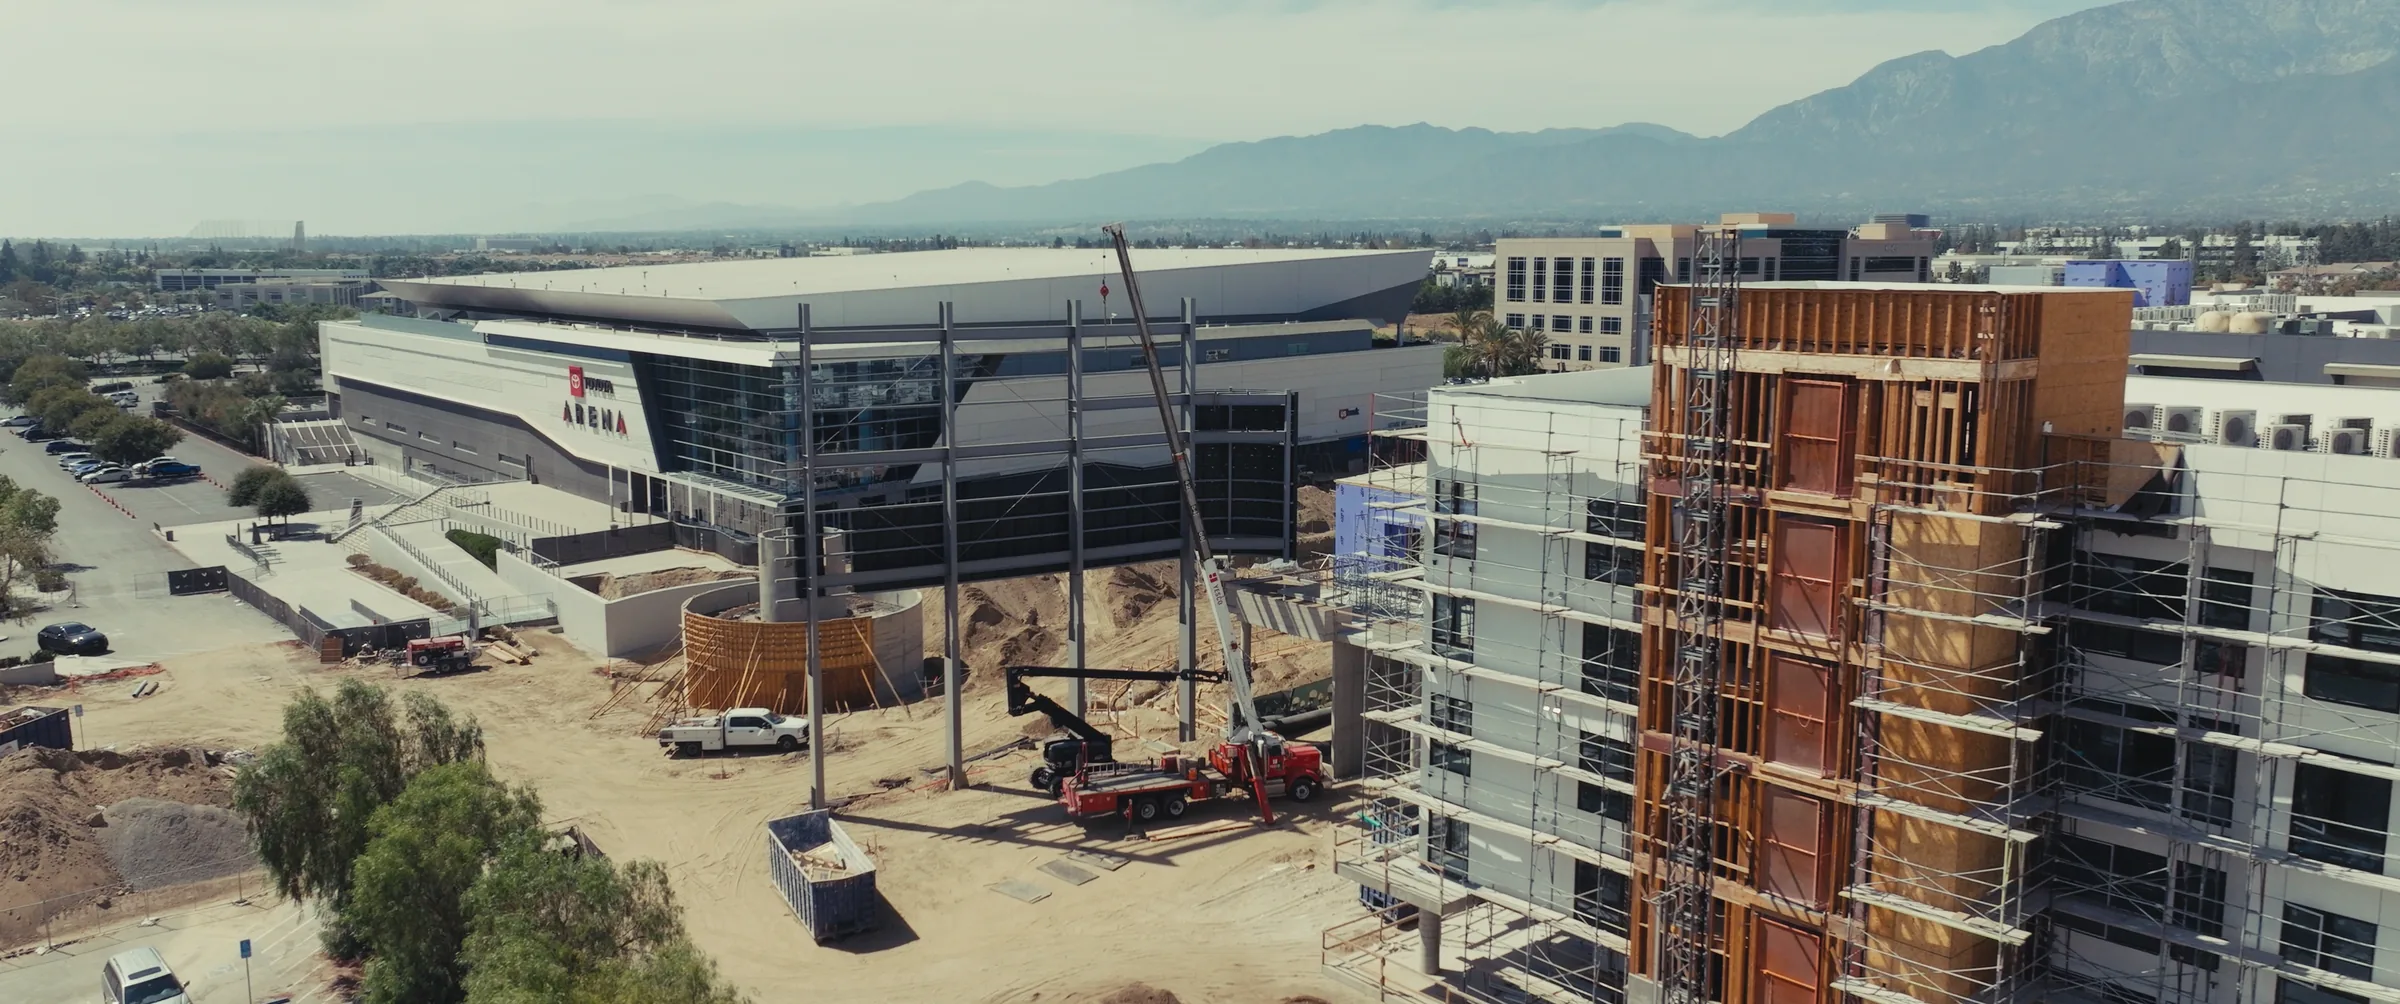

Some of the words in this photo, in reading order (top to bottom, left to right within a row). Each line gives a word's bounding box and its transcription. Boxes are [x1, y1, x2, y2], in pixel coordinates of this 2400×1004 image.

[584, 376, 614, 394] TOYOTA
[563, 400, 627, 434] ARENA
[1213, 583, 1223, 606] YESCO
